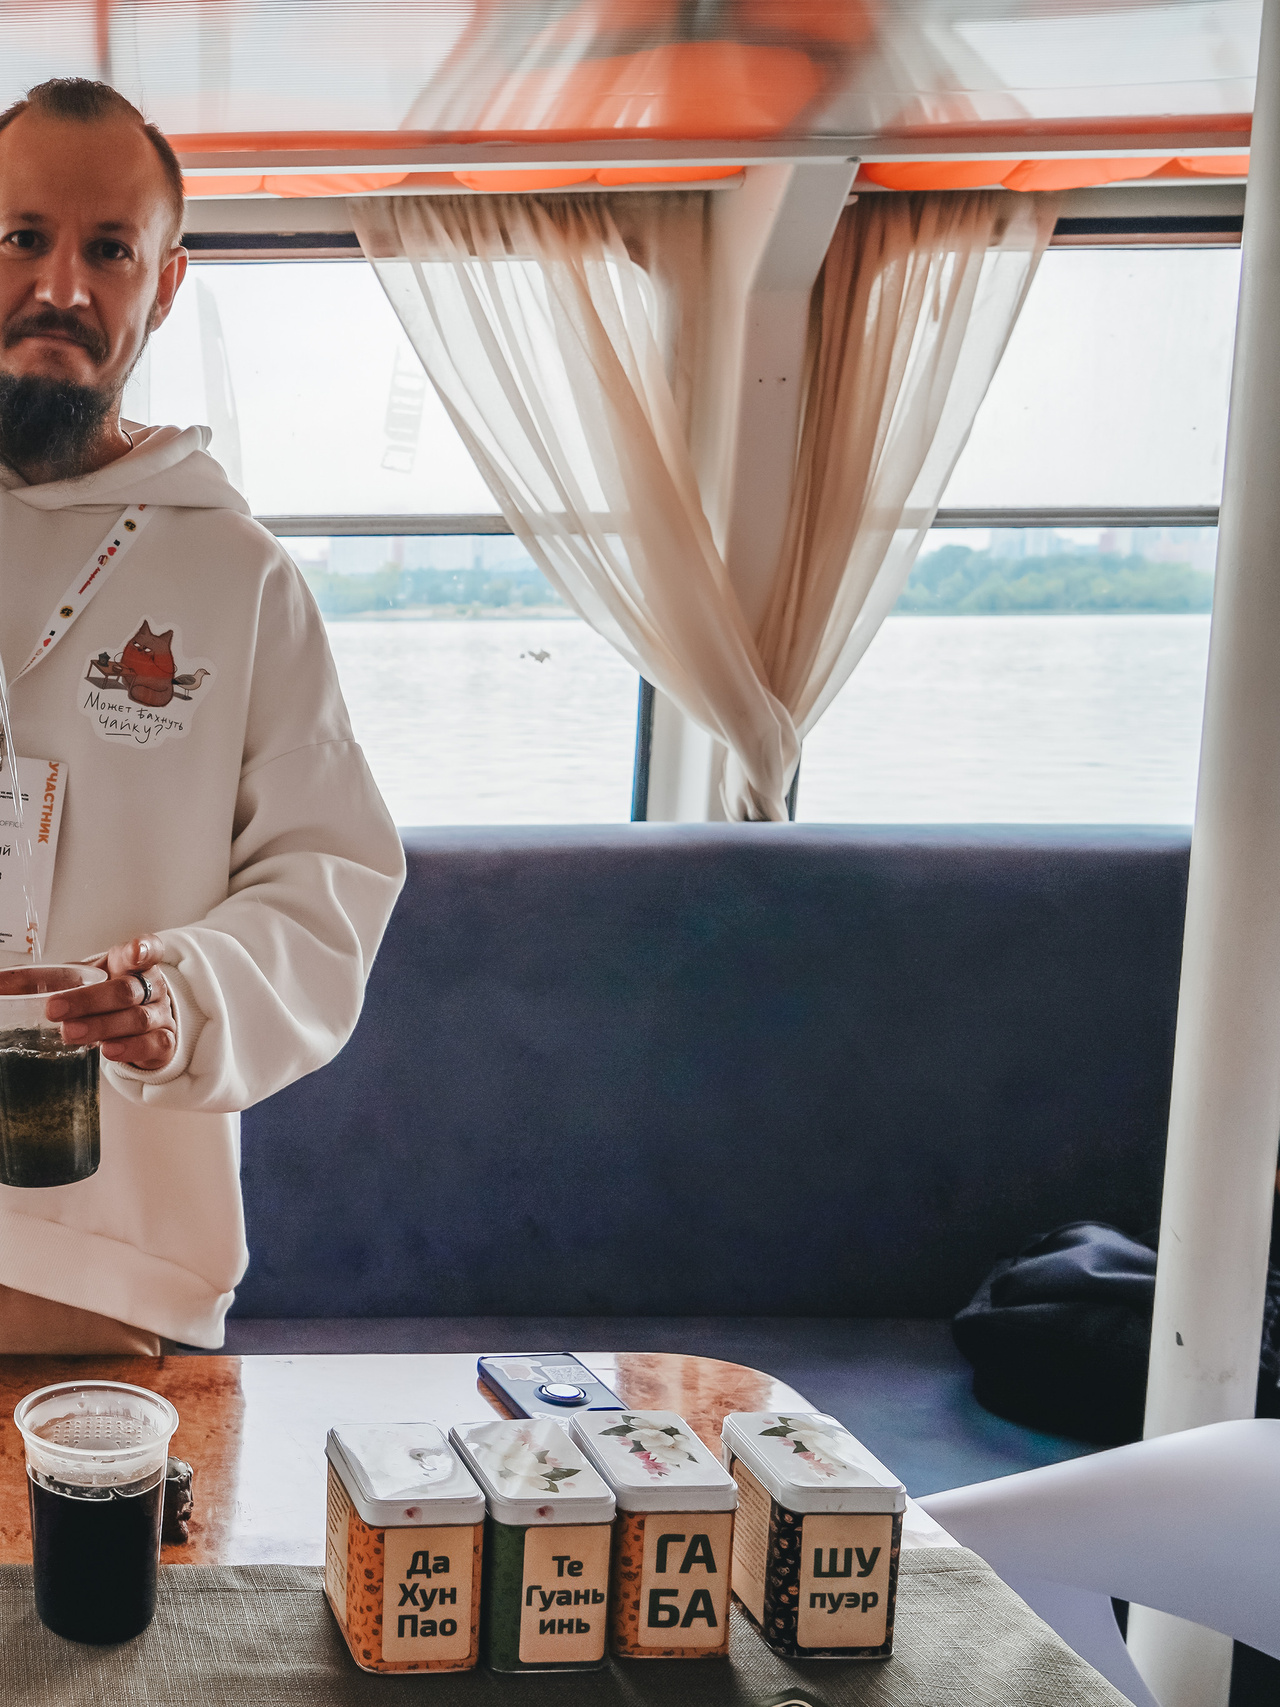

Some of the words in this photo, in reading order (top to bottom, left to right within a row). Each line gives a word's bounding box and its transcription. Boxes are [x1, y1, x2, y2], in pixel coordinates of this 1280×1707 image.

[38, 761, 59, 844] УЧАСТНИК
[406, 1550, 450, 1579] Да
[552, 1555, 584, 1577] Те
[655, 1533, 718, 1574] ГА
[813, 1546, 882, 1578] ШУ
[397, 1582, 457, 1612] Хун
[525, 1585, 605, 1612] Гуань
[647, 1588, 718, 1629] БА
[809, 1591, 879, 1614] пуэр
[397, 1614, 458, 1638] Пао
[538, 1618, 591, 1635] инь
